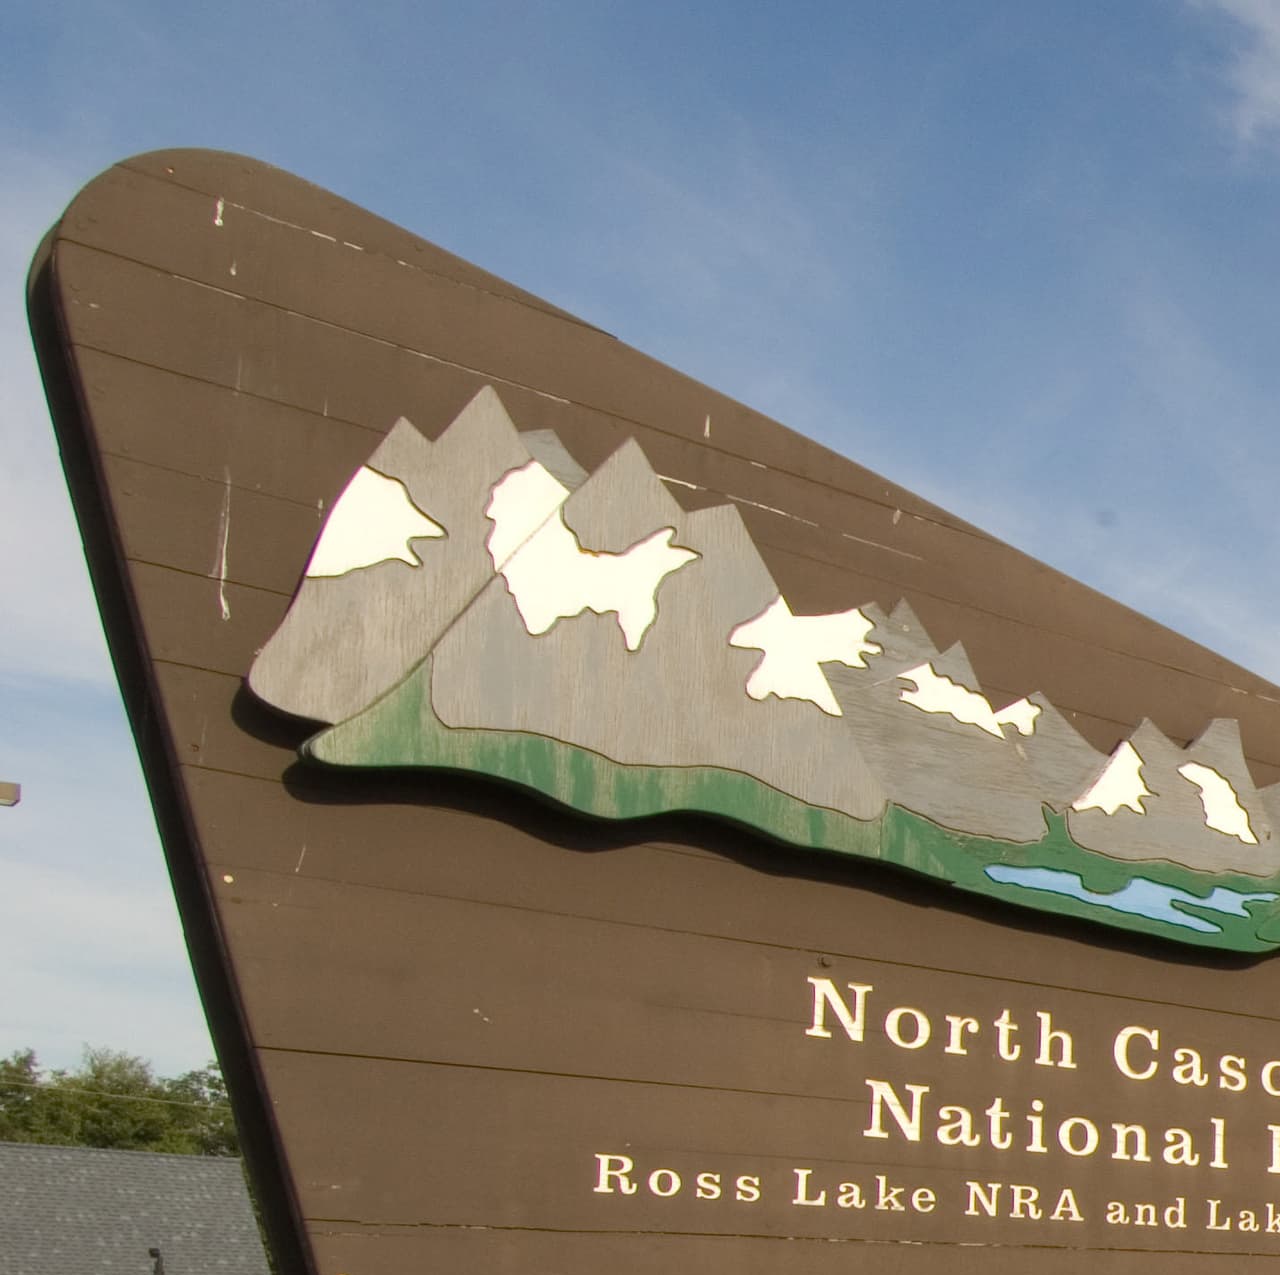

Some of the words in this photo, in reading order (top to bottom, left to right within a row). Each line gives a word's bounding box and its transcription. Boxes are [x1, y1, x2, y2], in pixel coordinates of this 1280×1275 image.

[805, 976, 1077, 1069] North
[863, 1079, 1229, 1169] National
[593, 1153, 761, 1202] Ross
[792, 1168, 936, 1213] Lake
[964, 1181, 1085, 1222] NRA
[1106, 1197, 1187, 1229] and
